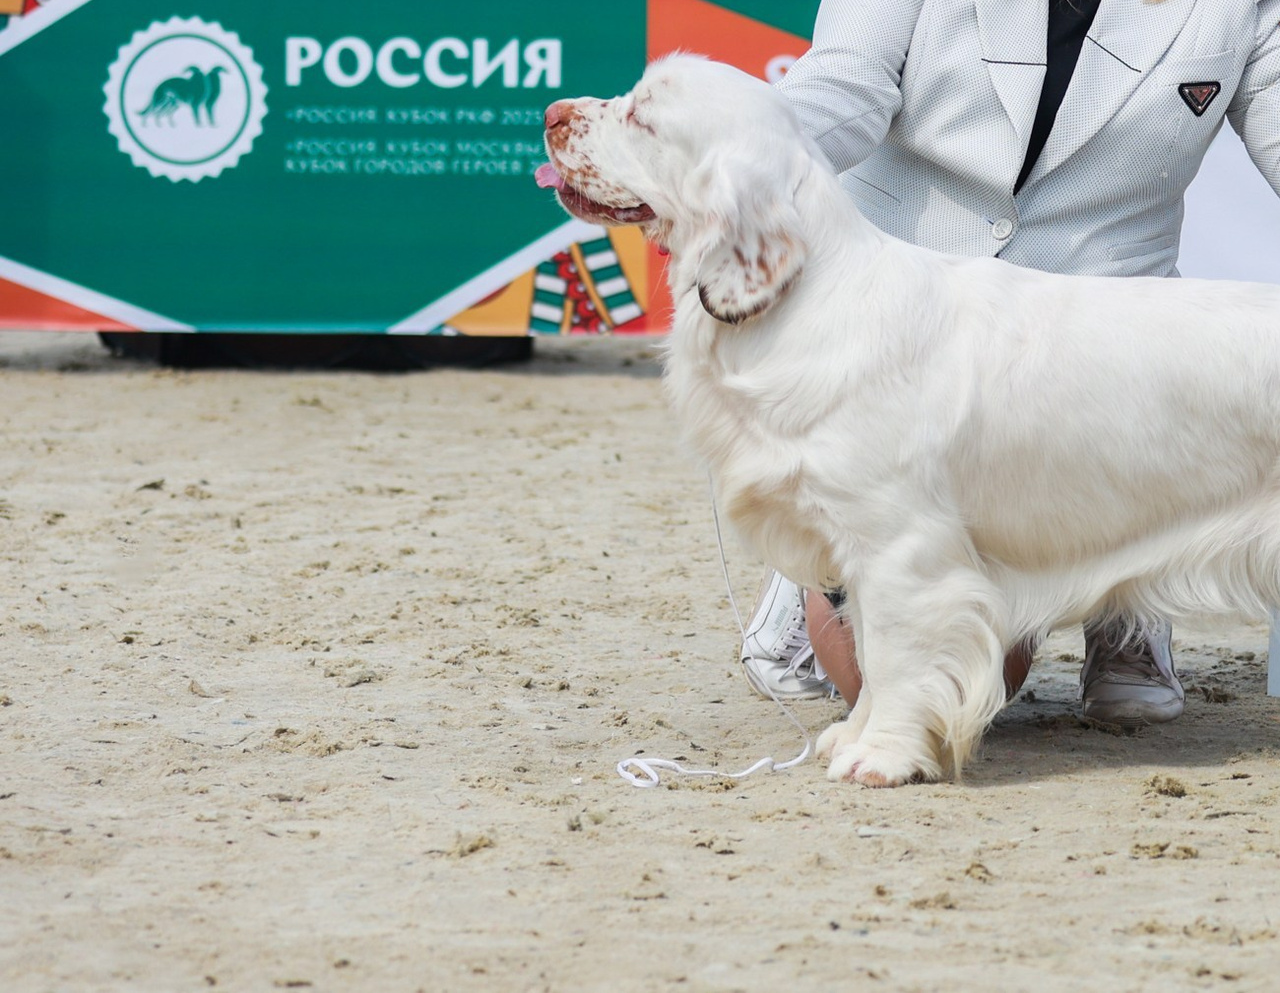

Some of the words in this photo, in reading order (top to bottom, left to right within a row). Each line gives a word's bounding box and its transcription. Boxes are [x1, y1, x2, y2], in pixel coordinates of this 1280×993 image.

[285, 36, 562, 88] РОССИЯ
[385, 108, 449, 125] КУБОК
[455, 108, 496, 125] РКФ
[385, 139, 449, 156] КУБОК
[284, 159, 347, 175] КУБОК
[353, 159, 446, 176] ГОРОДОВ
[453, 159, 523, 175] ГЕРОЕВ
